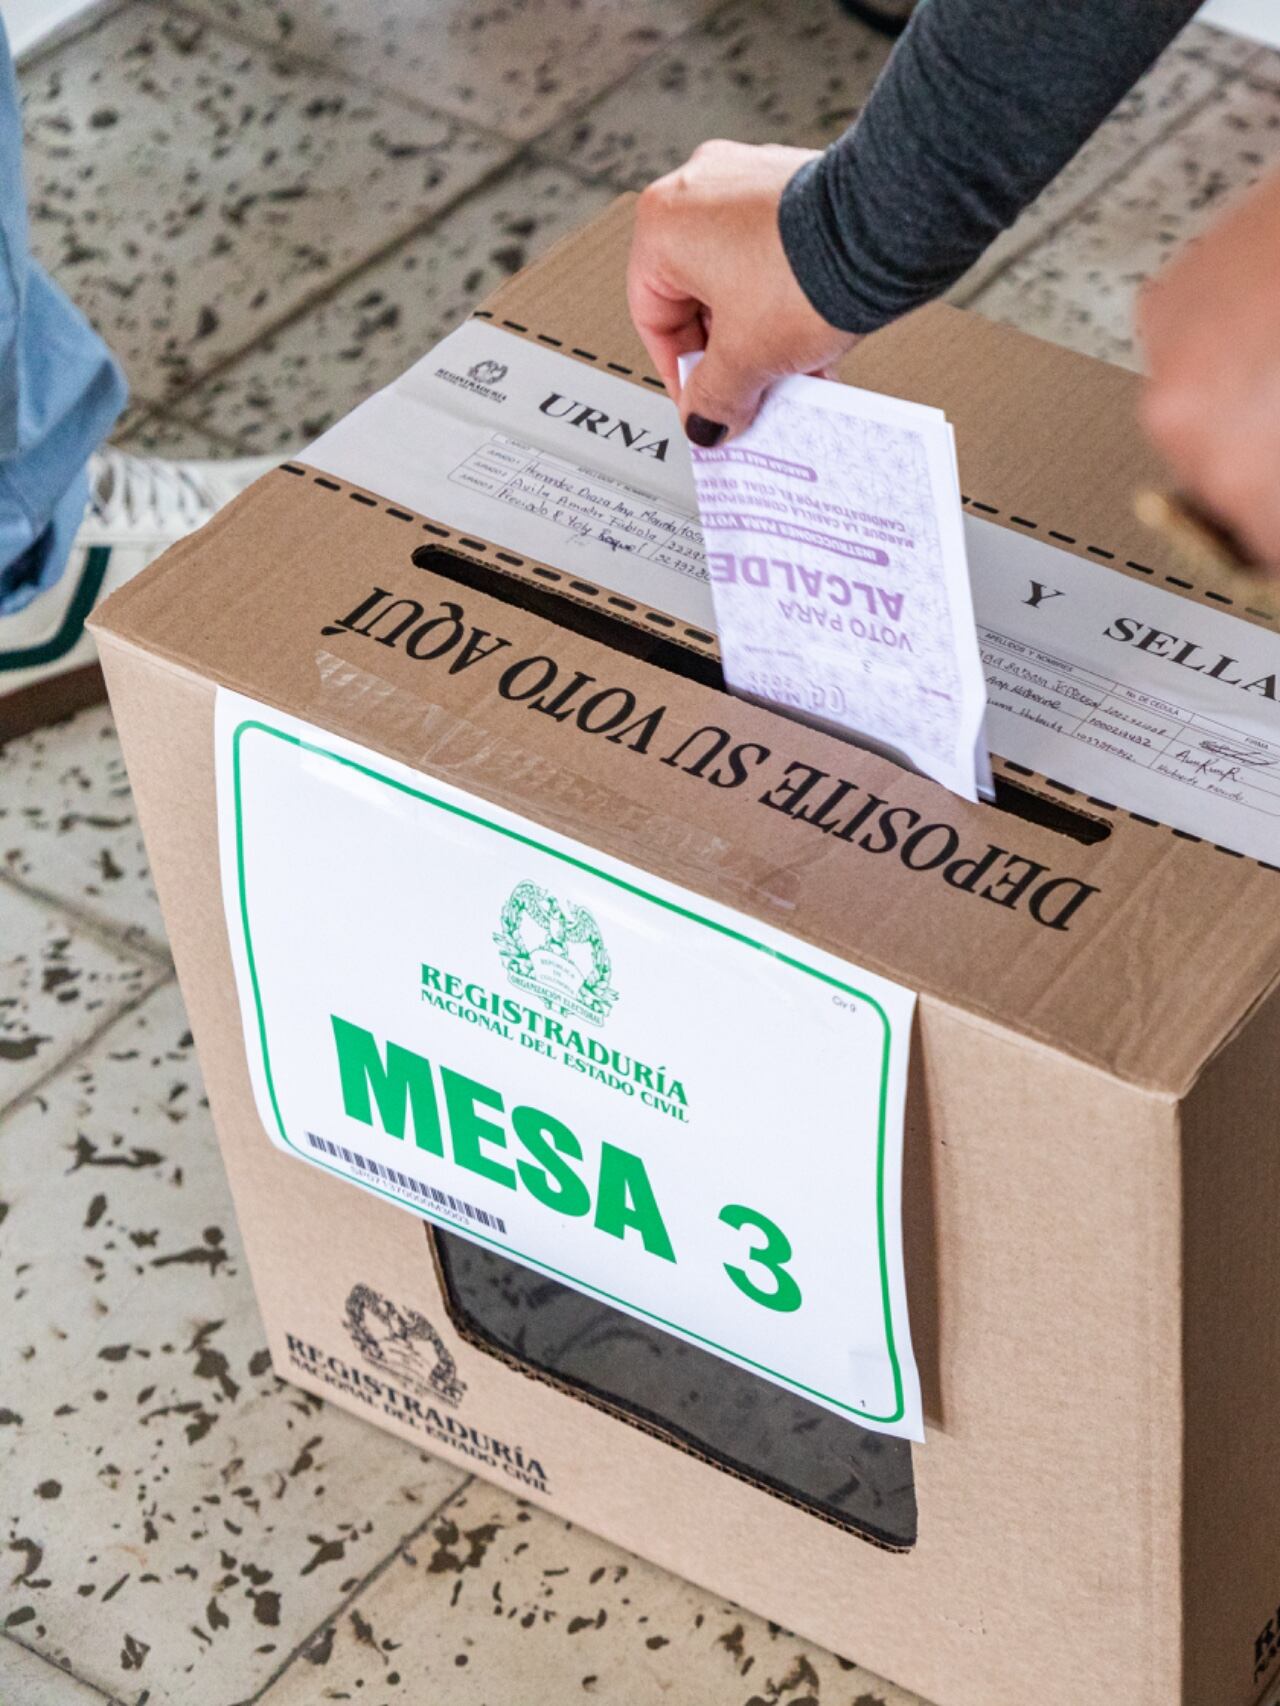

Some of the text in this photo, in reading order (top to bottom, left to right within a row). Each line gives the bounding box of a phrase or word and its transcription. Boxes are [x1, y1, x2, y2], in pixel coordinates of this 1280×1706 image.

[539, 392, 668, 461] URNA
[705, 551, 906, 621] ALCALDE
[778, 598, 914, 653] VOTO PARA
[1021, 579, 1067, 609] Y
[320, 587, 1101, 931] DEPOSITE SU VOTO AQUÍ
[421, 962, 690, 1106] REGISTRADURÍA
[421, 989, 691, 1125] NACIONAL DEL ESTADO CIVIL
[330, 1013, 803, 1313] MESA 3
[285, 1332, 549, 1481] REGISTRADURÍA
[288, 1355, 379, 1407] NACIONAL
[383, 1402, 421, 1430] DEL
[425, 1424, 497, 1468] ESTADO
[503, 1464, 553, 1496] CIVIL
